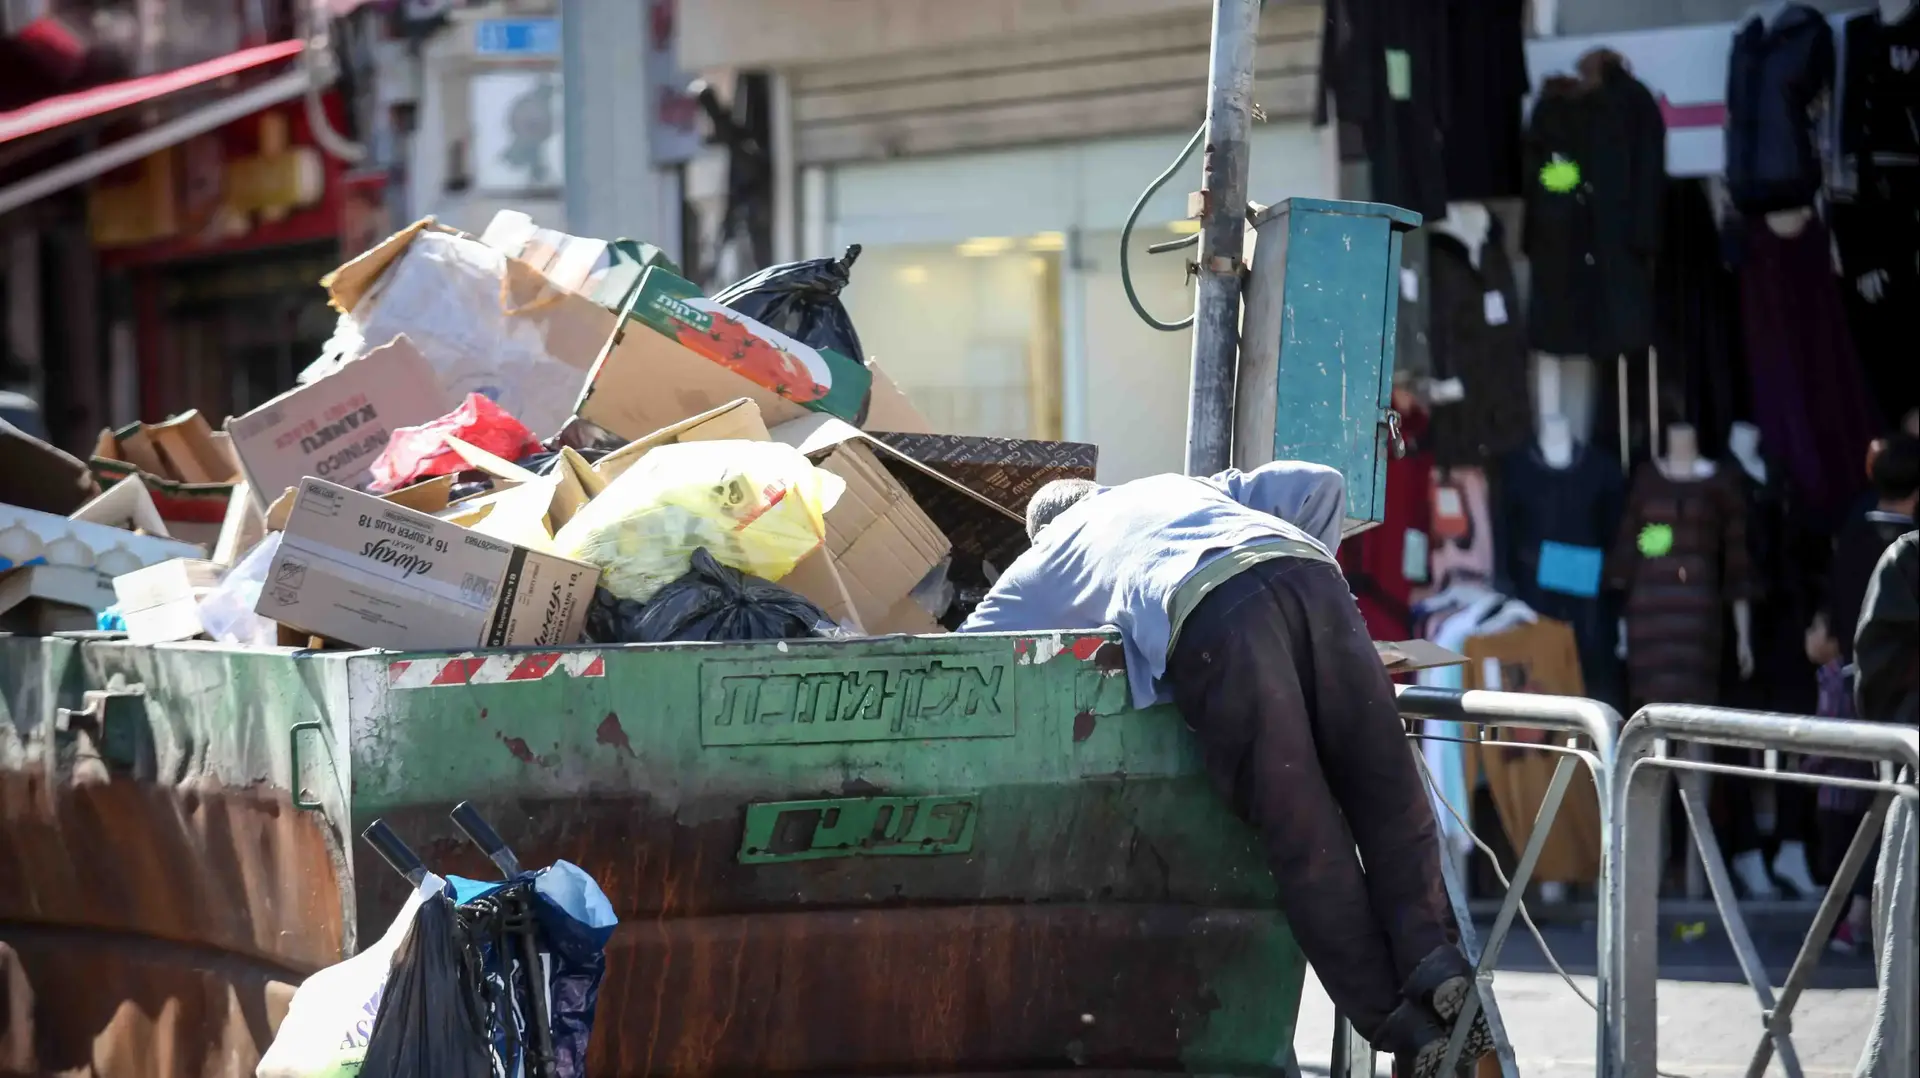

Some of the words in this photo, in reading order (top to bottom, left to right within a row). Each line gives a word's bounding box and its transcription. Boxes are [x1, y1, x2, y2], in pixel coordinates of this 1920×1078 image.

[358, 514, 373, 528] 18
[375, 519, 397, 534] PLUS
[399, 527, 425, 544] SUPER
[391, 540, 416, 552] MAXI
[435, 541, 449, 553] 16
[360, 539, 433, 579] always
[509, 573, 517, 585] 18
[534, 581, 561, 646] lways
[553, 619, 564, 646] UPER
[561, 592, 573, 617] PLUS
[569, 573, 578, 587] 18
[340, 1018, 376, 1050] AS
